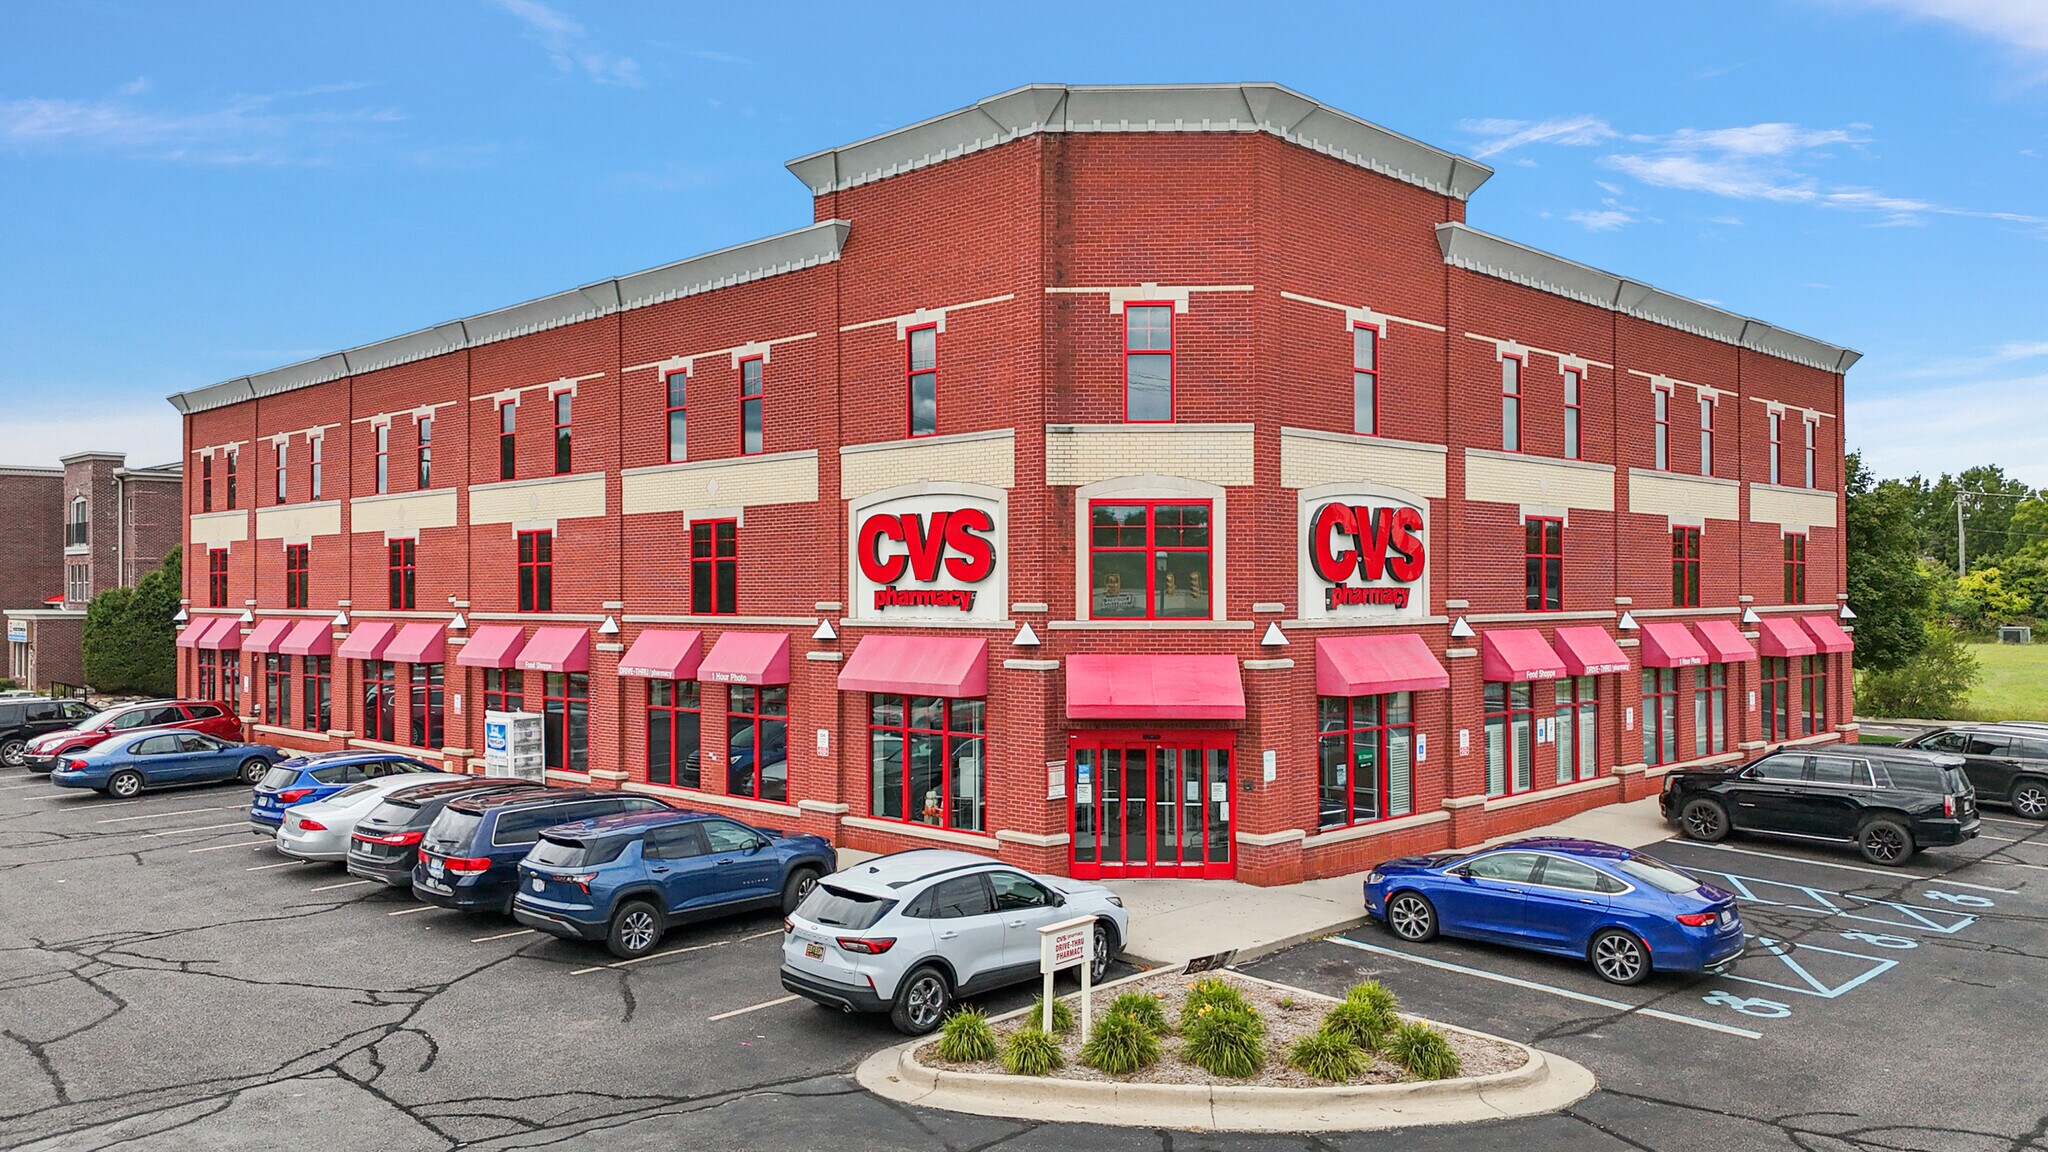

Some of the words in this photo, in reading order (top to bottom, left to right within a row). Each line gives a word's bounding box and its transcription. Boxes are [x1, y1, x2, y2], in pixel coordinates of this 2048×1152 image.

[858, 508, 997, 584] CVS
[1309, 502, 1426, 583] CVS
[874, 585, 977, 612] pharmacy
[1325, 582, 1411, 611] pharmacy
[525, 661, 536, 669] Food
[536, 662, 552, 671] Shoppe
[619, 666, 649, 676] DRIVE-THRU
[1586, 664, 1611, 674] DRIVE-THRU
[715, 673, 729, 681] Hour
[730, 673, 747, 682] Photo
[1526, 670, 1539, 679] Food
[1539, 670, 1556, 679] Shoppe
[1055, 938, 1085, 952] DRIVE-THRU
[1056, 946, 1084, 960] PHARMACY
